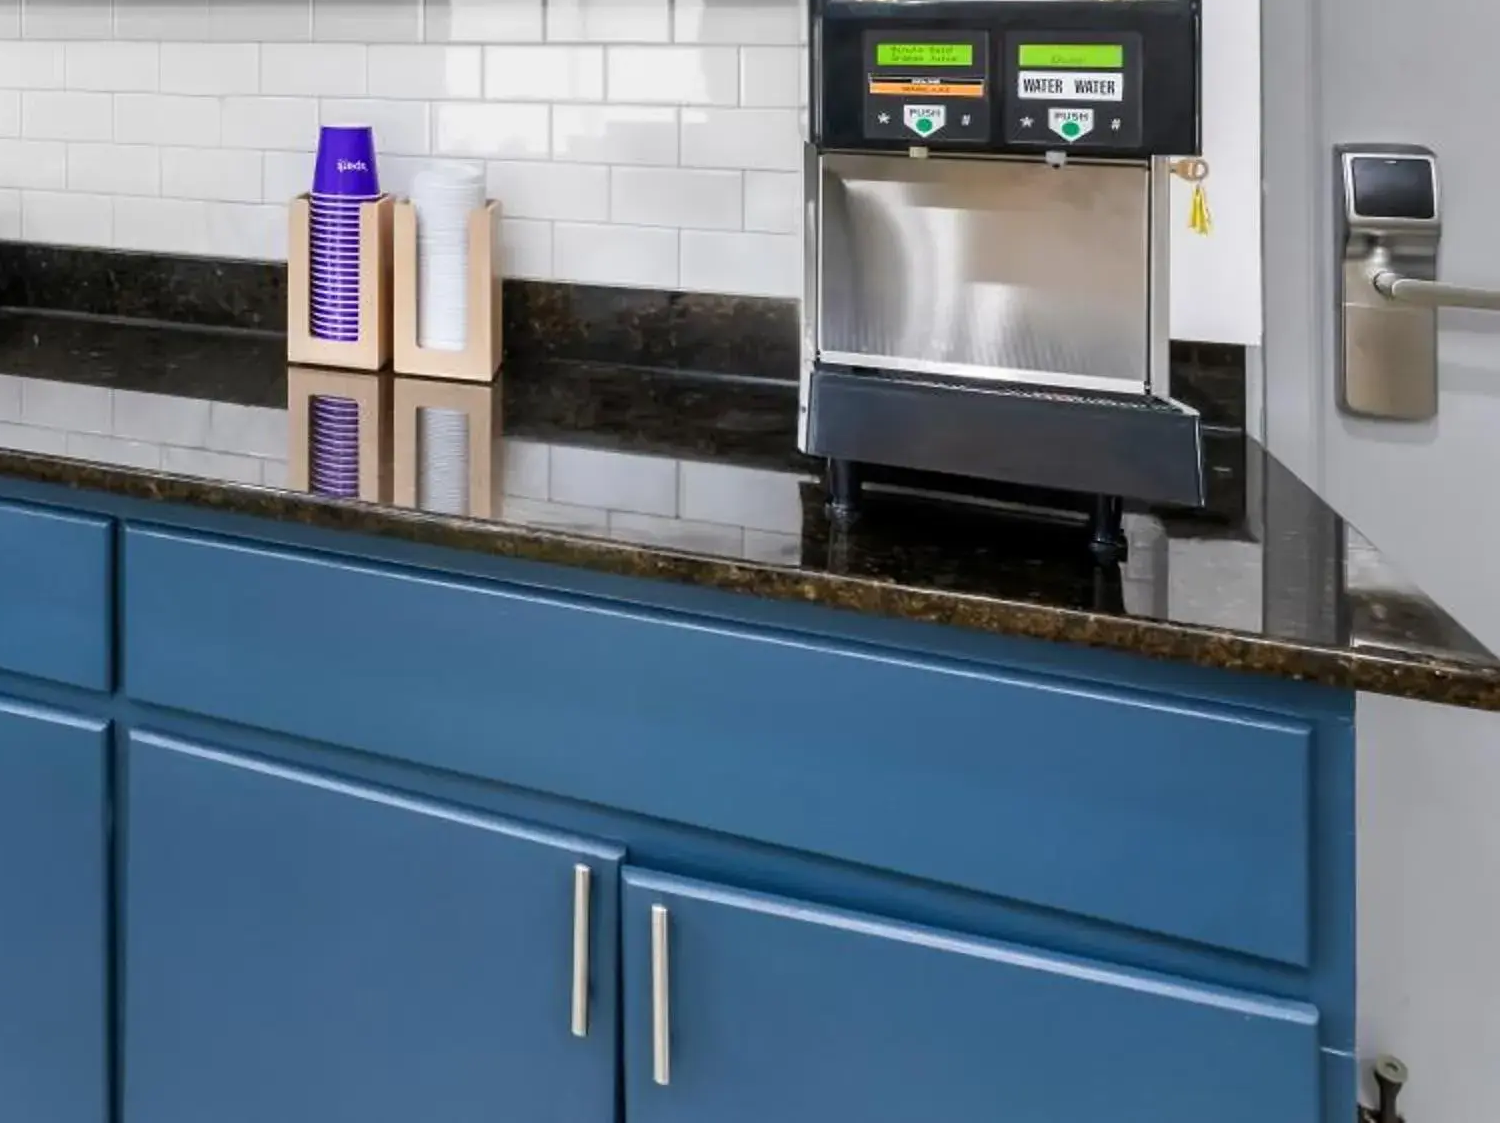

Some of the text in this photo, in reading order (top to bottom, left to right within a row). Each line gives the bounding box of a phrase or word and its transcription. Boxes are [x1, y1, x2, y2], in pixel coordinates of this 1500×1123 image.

[1023, 78, 1116, 95] WATER WATER
[908, 108, 941, 118] PUSH
[1054, 111, 1090, 122] PUSH
